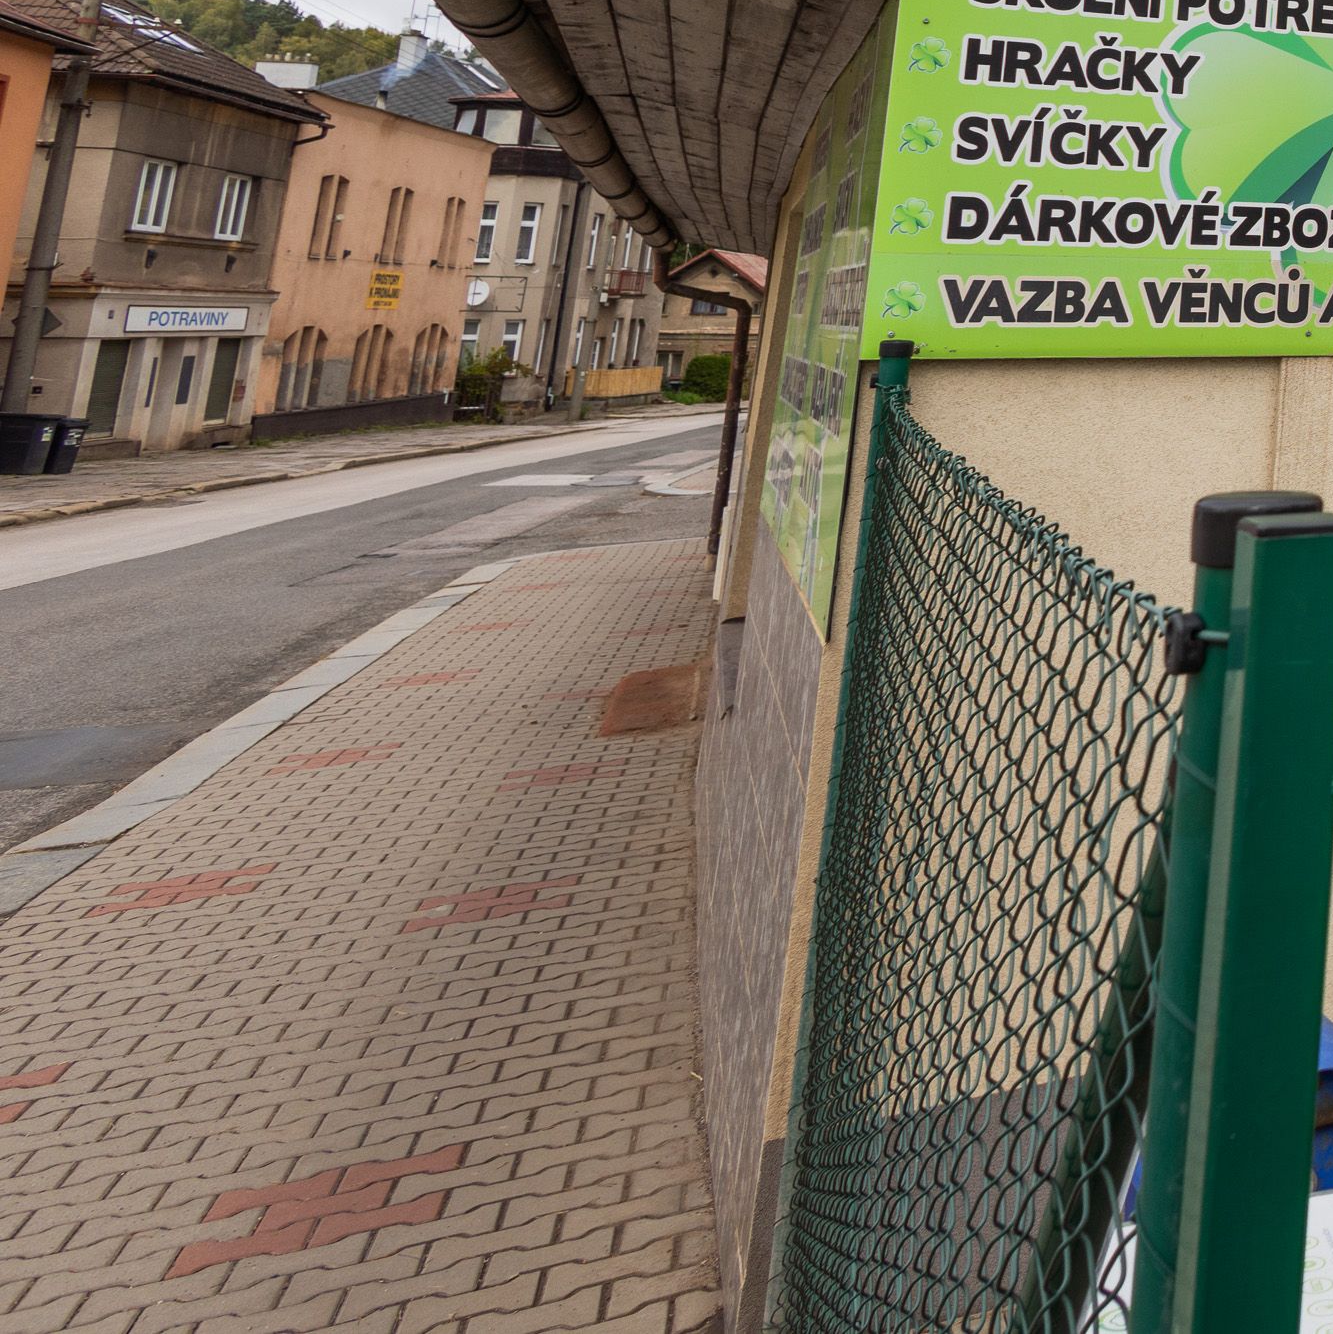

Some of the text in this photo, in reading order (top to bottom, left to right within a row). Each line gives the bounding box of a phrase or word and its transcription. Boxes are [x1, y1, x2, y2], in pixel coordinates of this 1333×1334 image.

[964, 36, 1201, 95] HRAČKY
[956, 107, 1167, 168] SVÍČKY
[947, 184, 1219, 246] DÁRKOVÉ
[148, 311, 229, 326] POTRAVINY
[943, 279, 1129, 324] VAZBA
[1143, 268, 1310, 324] VĚNCŮ
